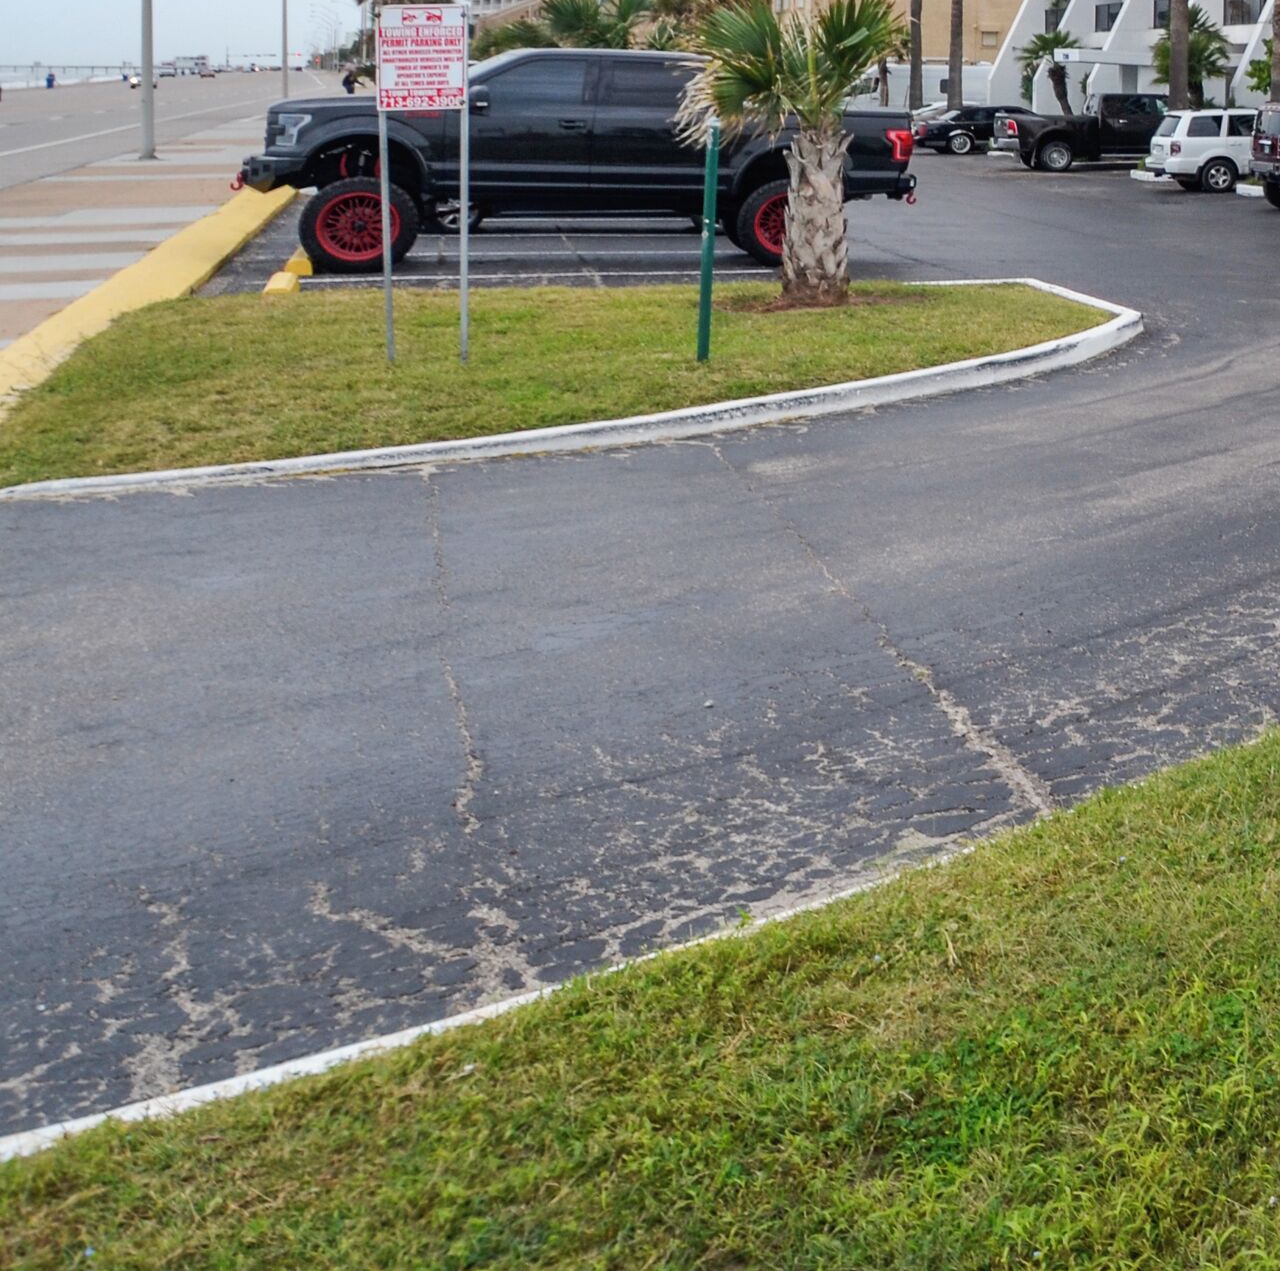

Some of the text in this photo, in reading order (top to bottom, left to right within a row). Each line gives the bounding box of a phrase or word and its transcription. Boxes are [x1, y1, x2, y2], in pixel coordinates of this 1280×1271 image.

[382, 27, 462, 37] TOWING ENFORCED
[382, 38, 461, 48] PERMIT PARKING ONLY
